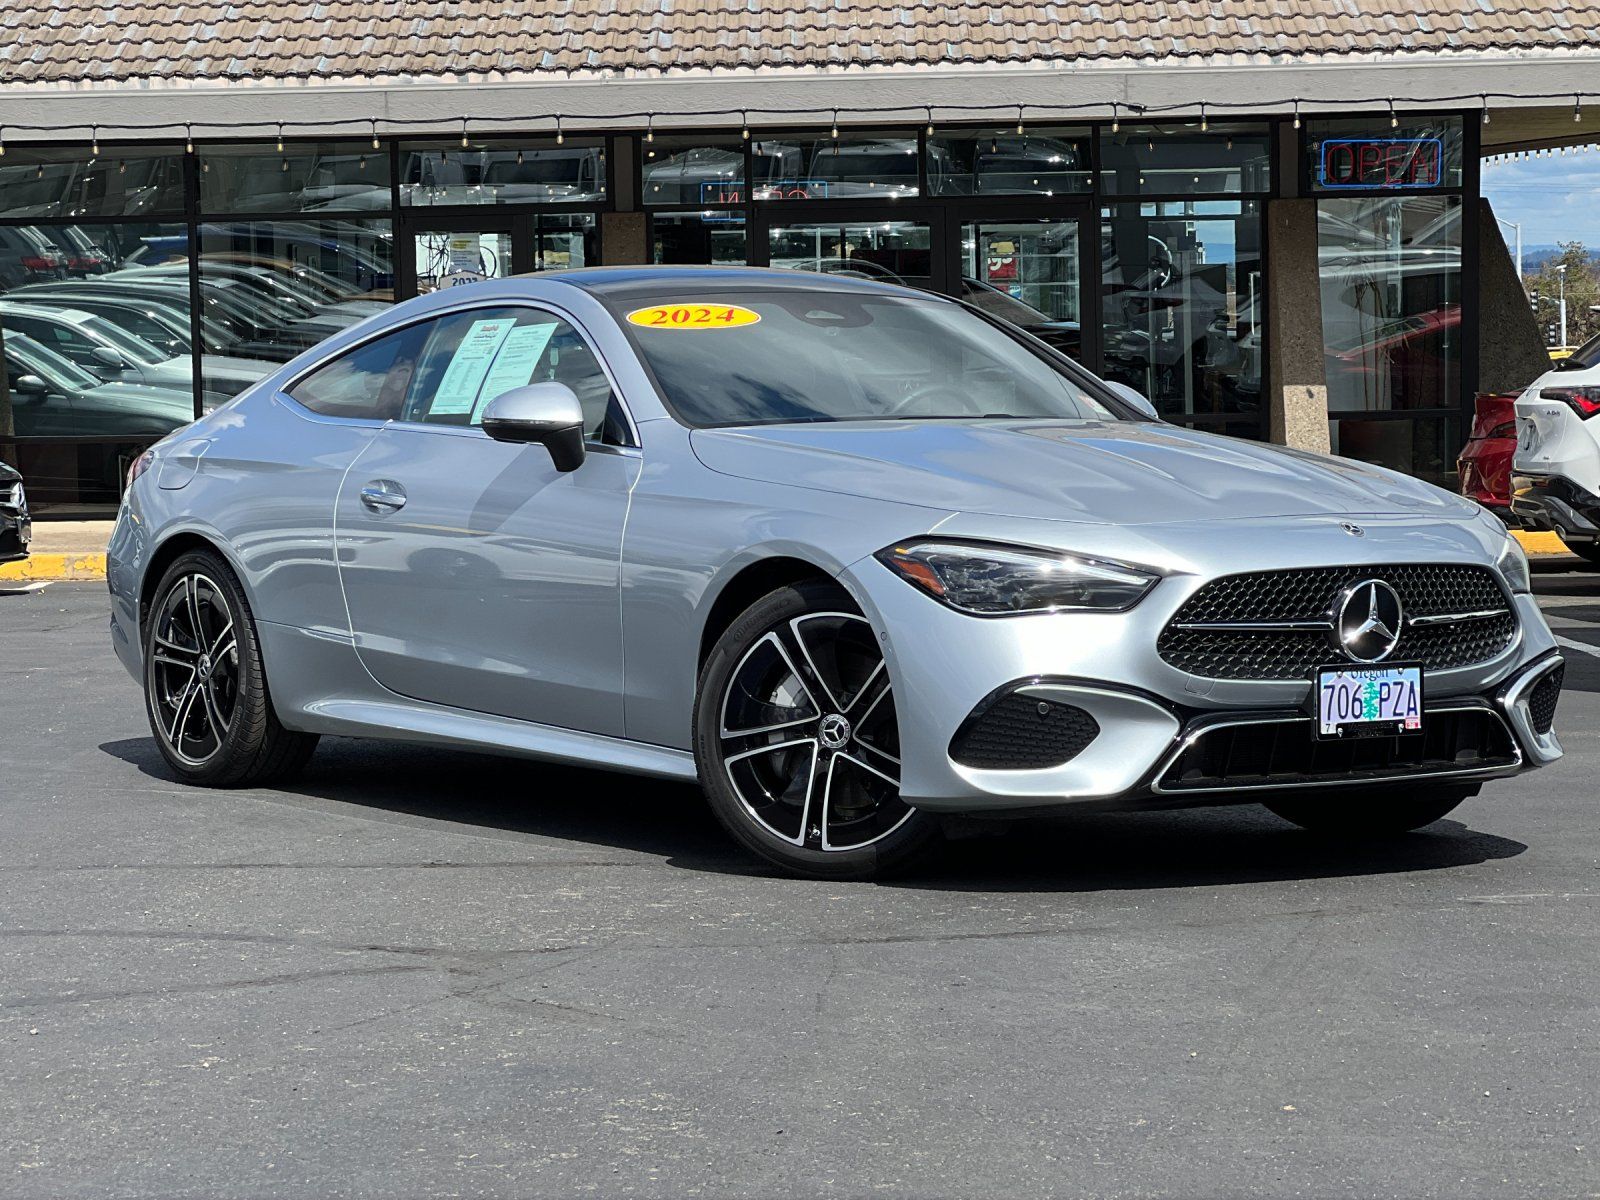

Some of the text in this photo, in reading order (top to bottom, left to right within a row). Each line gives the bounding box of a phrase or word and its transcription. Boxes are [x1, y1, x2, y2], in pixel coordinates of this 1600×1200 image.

[1328, 145, 1437, 184] OPEN
[650, 307, 736, 325] 2024
[1350, 669, 1389, 682] Oregon
[1323, 681, 1418, 721] 706 PZA
